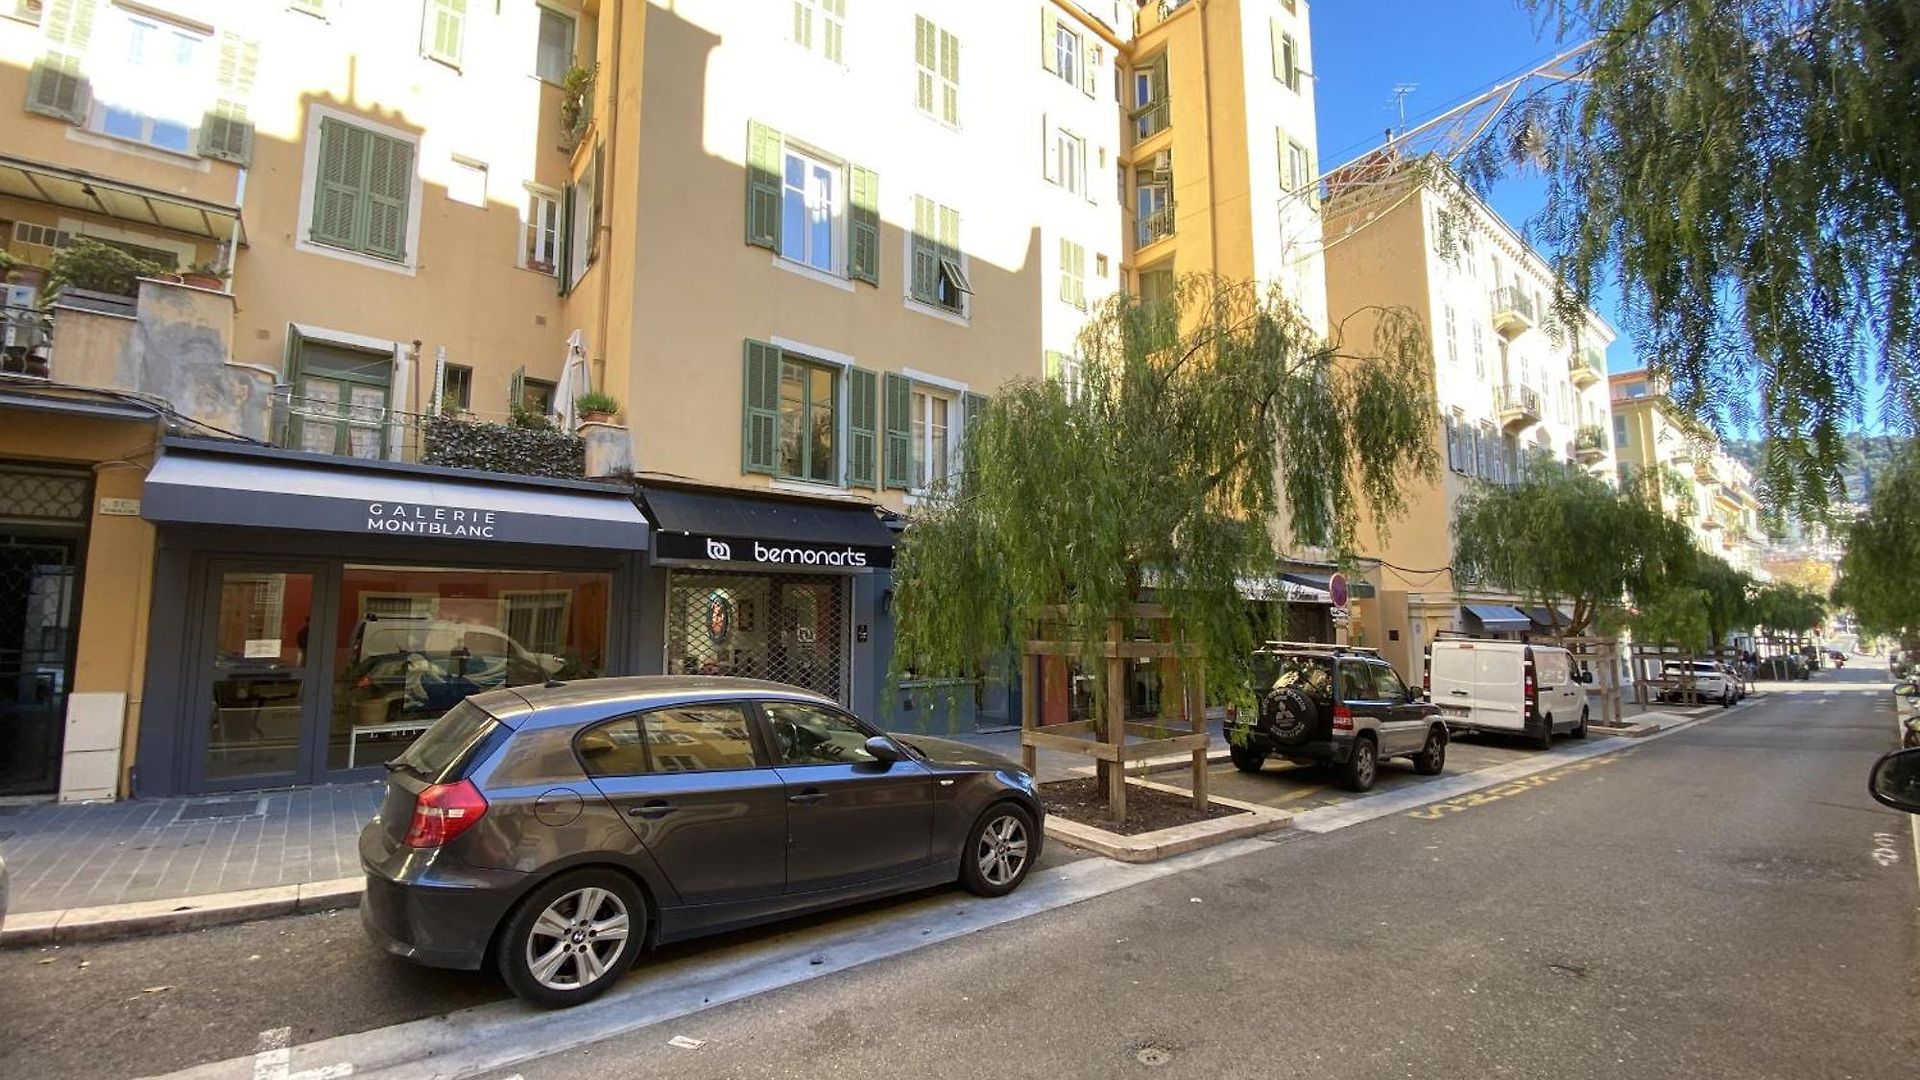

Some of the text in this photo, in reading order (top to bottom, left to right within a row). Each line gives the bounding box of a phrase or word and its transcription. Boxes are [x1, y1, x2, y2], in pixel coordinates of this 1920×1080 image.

[369, 503, 496, 524] GALERIE
[367, 518, 494, 538] MONTBLANC
[754, 541, 867, 566] bemonarts
